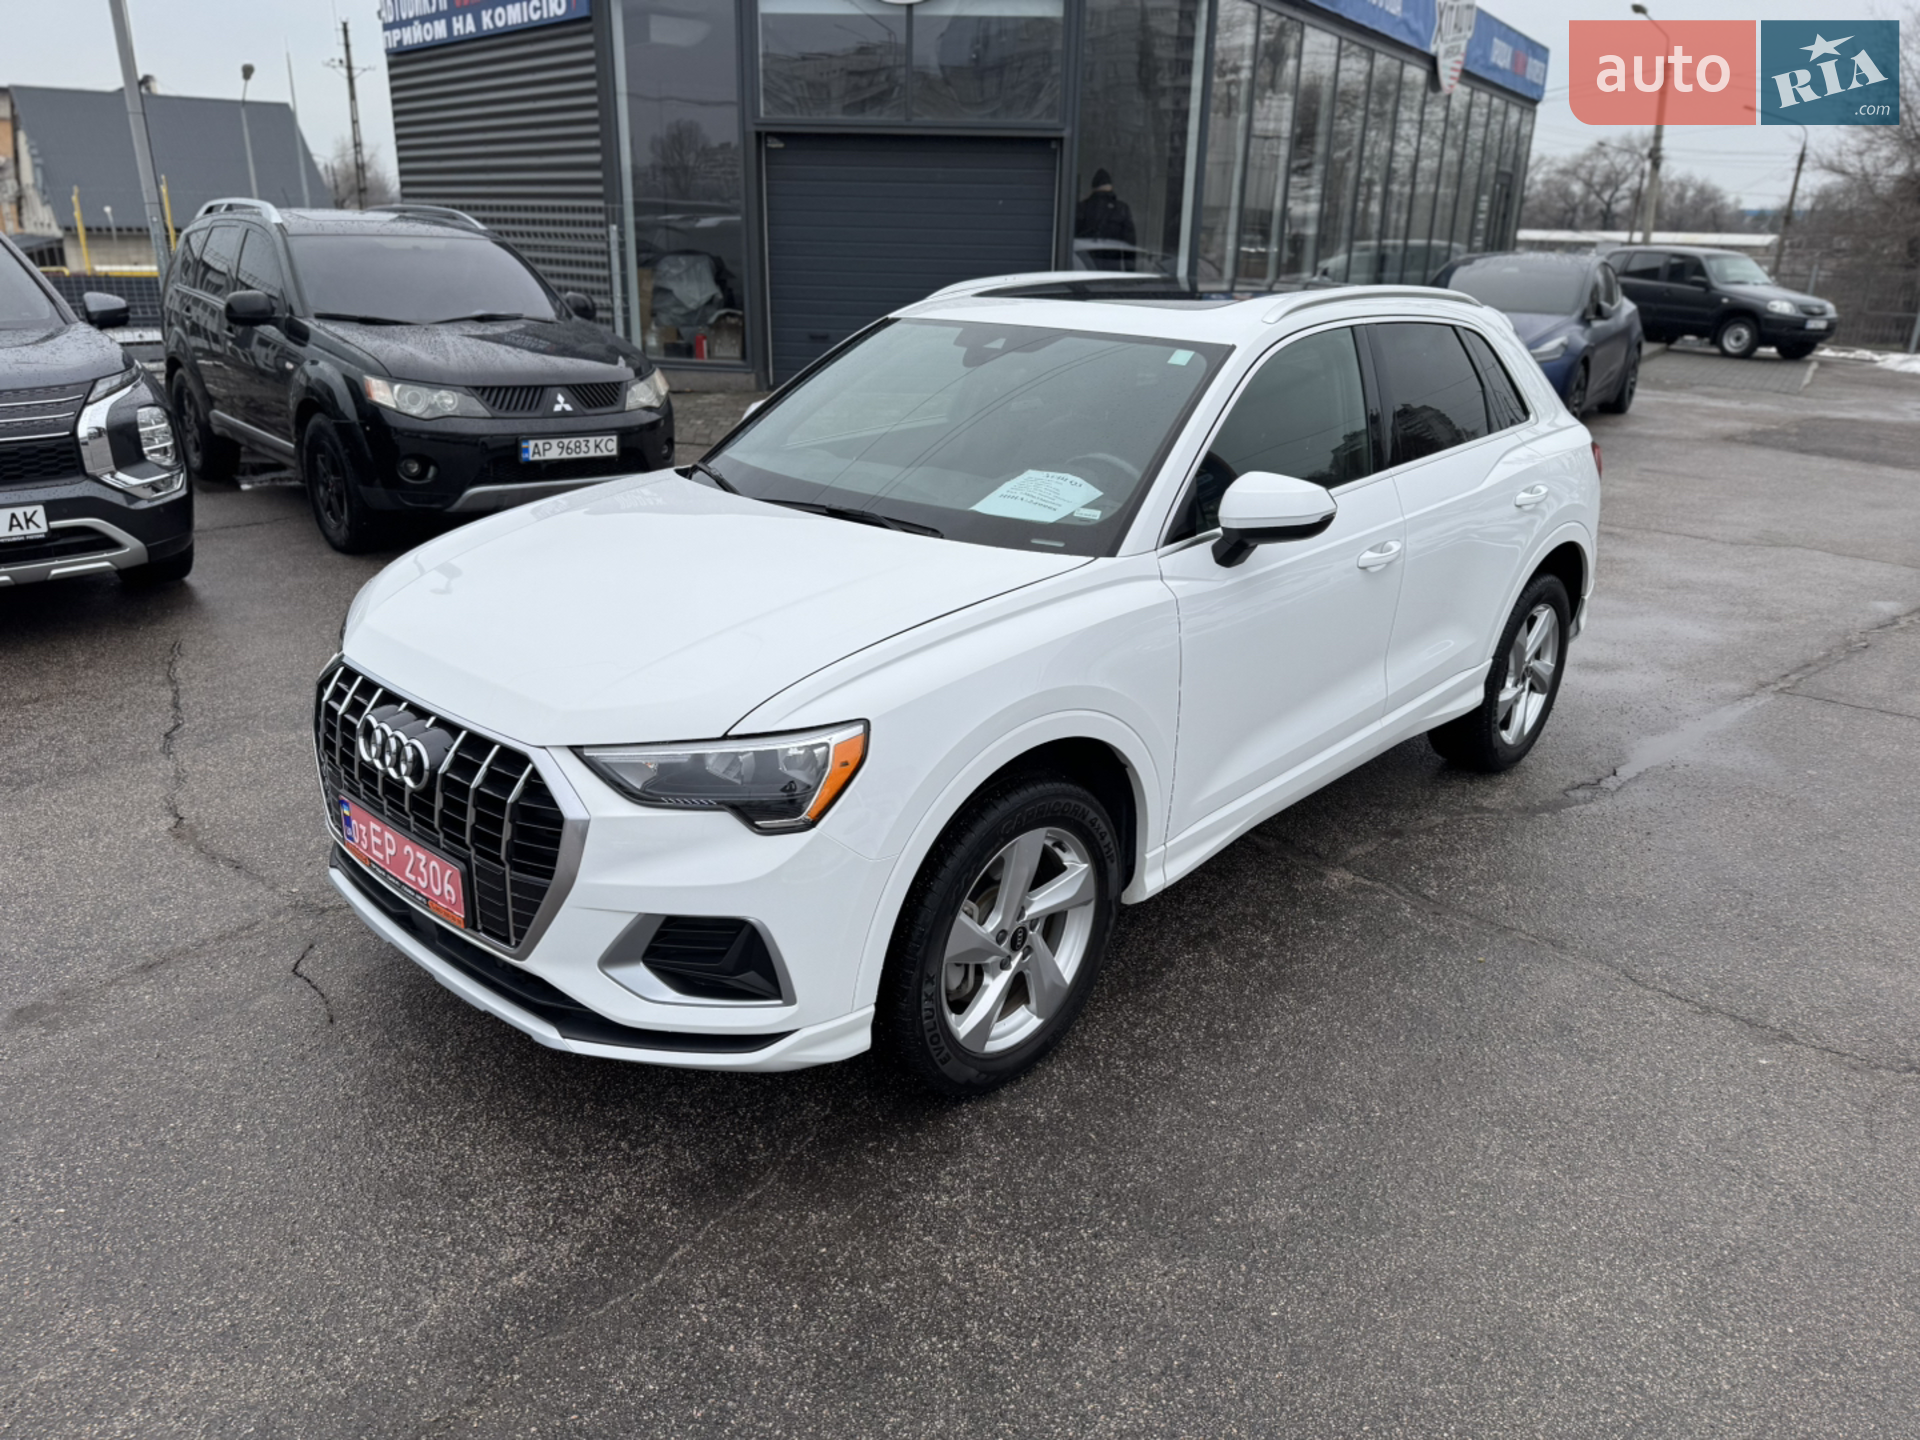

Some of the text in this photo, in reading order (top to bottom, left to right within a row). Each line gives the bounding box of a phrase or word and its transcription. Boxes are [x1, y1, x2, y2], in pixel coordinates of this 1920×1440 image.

[383, 0, 567, 49] ПРИЙОМ НА КОМІСІЮ
[531, 438, 614, 458] AP 9683 KC
[8, 509, 42, 532] AK
[1001, 800, 1091, 835] CAPRICORN
[351, 819, 368, 850] 03
[370, 820, 397, 865] EP
[404, 845, 456, 905] 2306
[923, 971, 953, 1067] EVOLUXX
